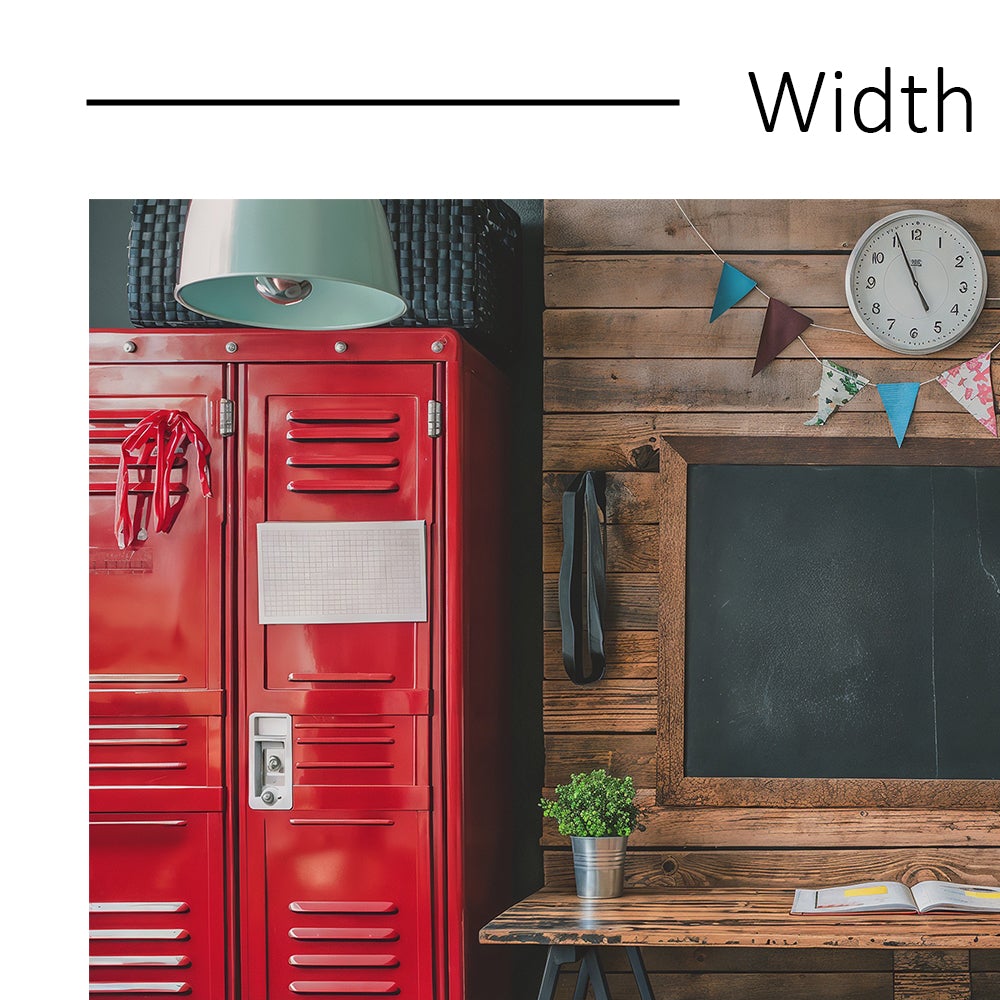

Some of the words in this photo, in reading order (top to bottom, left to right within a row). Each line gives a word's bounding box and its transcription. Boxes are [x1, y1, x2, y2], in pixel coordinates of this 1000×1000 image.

[911, 229, 922, 241] 12
[938, 237, 942, 248] 1
[955, 255, 965, 268] 2
[866, 276, 876, 289] 9
[959, 281, 968, 293] 3
[872, 303, 881, 314] 8
[950, 304, 959, 316] 4
[887, 319, 896, 330] 7
[933, 321, 942, 333] 5
[909, 328, 919, 339] 6
